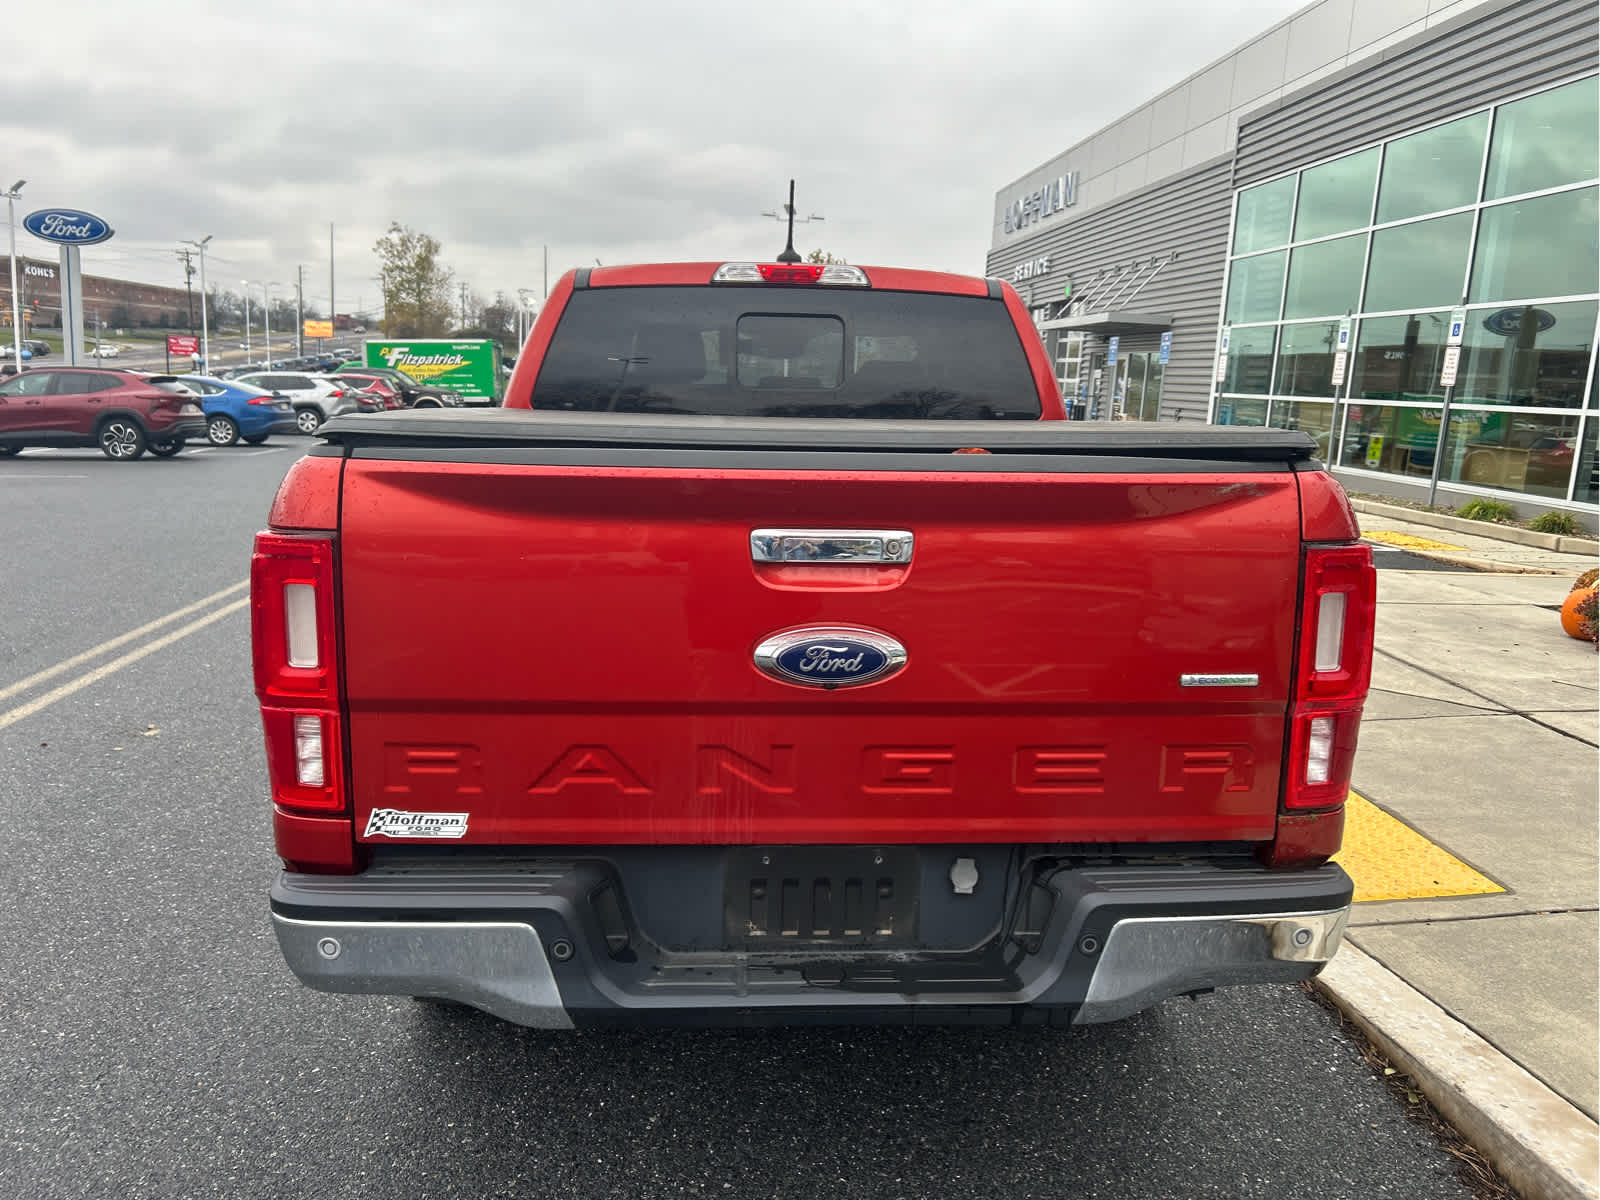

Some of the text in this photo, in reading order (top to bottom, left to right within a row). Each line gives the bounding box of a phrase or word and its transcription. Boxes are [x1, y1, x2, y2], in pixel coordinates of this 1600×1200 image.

[1003, 171, 1079, 233] HOFFMAN
[40, 213, 91, 238] Ford
[25, 265, 54, 278] KOHL'S
[1014, 256, 1050, 281] SERVICE
[385, 347, 463, 367] Fitzpatrick
[799, 645, 865, 672] Ford
[383, 741, 1254, 794] RANGER
[388, 815, 460, 825] Hoffman
